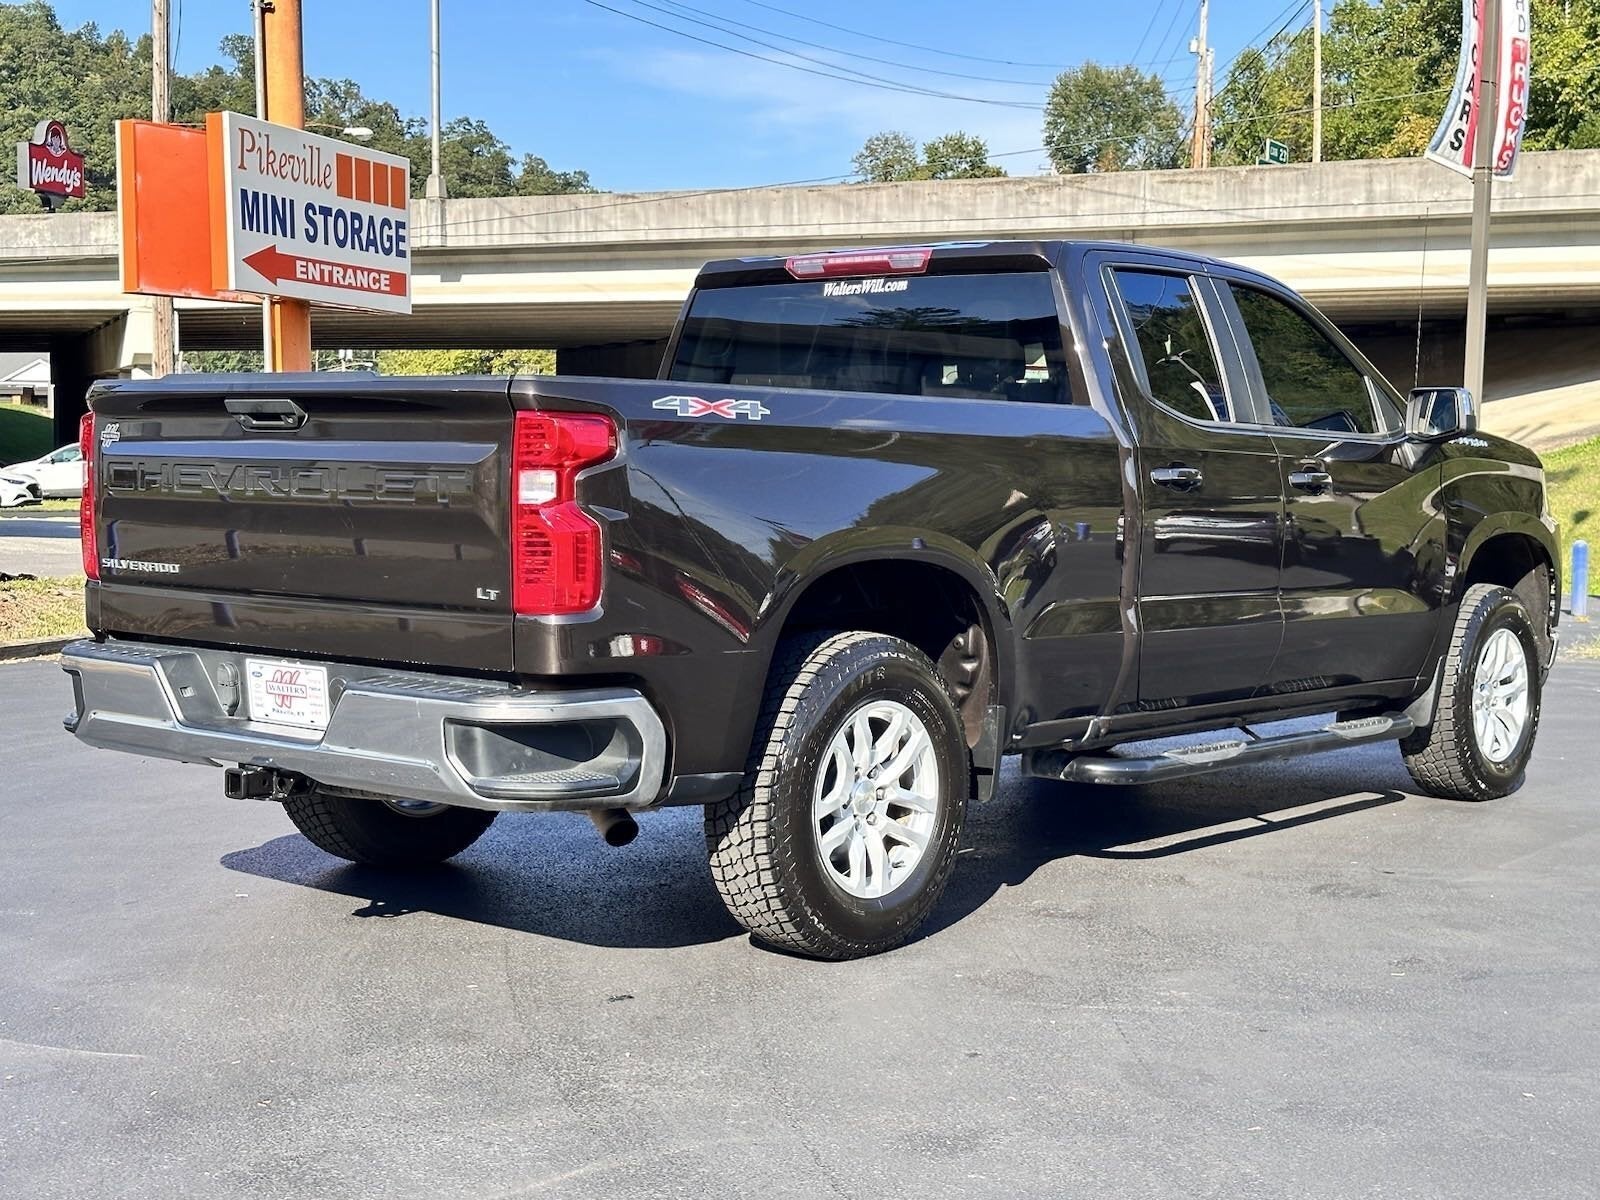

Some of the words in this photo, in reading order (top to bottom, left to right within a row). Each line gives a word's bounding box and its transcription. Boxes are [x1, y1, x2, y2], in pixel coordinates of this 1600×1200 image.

[1498, 38, 1527, 168] TRUCKS
[31, 158, 82, 193] Wendy's
[238, 127, 333, 190] Pikeville
[240, 188, 296, 239] MINI
[304, 201, 407, 258] STORAGE
[295, 260, 391, 292] ENTRANCE
[823, 279, 909, 297] WaltersWill.com
[106, 461, 473, 504] CHEVROLET
[101, 557, 180, 574] SILVERADO
[476, 587, 500, 601] LT
